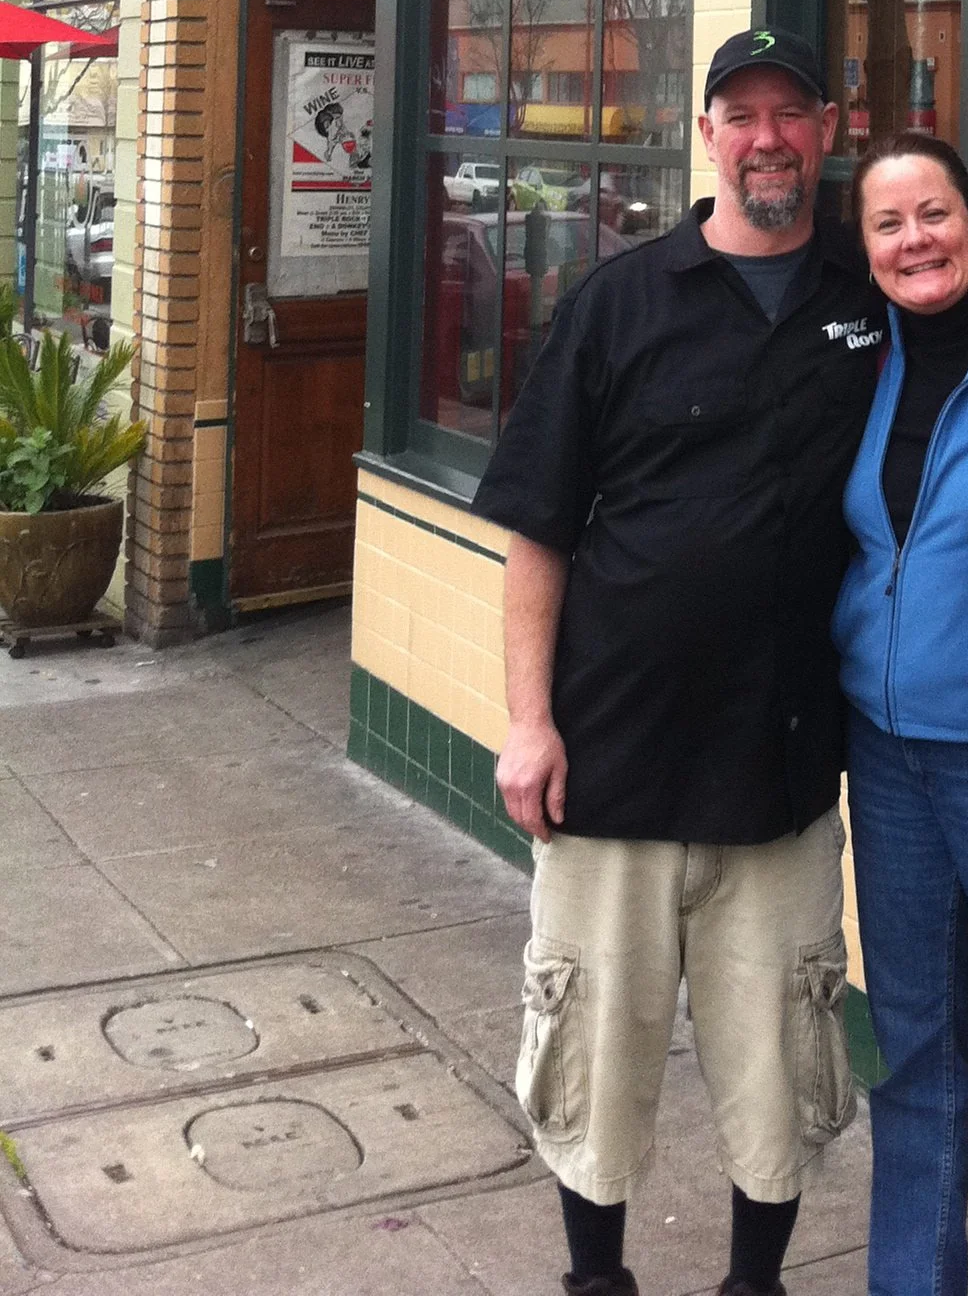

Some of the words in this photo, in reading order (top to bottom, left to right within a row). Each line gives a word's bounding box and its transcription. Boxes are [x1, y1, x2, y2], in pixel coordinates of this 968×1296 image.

[307, 56, 326, 66] SEE
[327, 57, 337, 67] IT
[338, 55, 365, 68] LIVE
[323, 72, 362, 85] SUPER
[303, 86, 340, 115] WINE
[821, 317, 868, 341] TRIPLE
